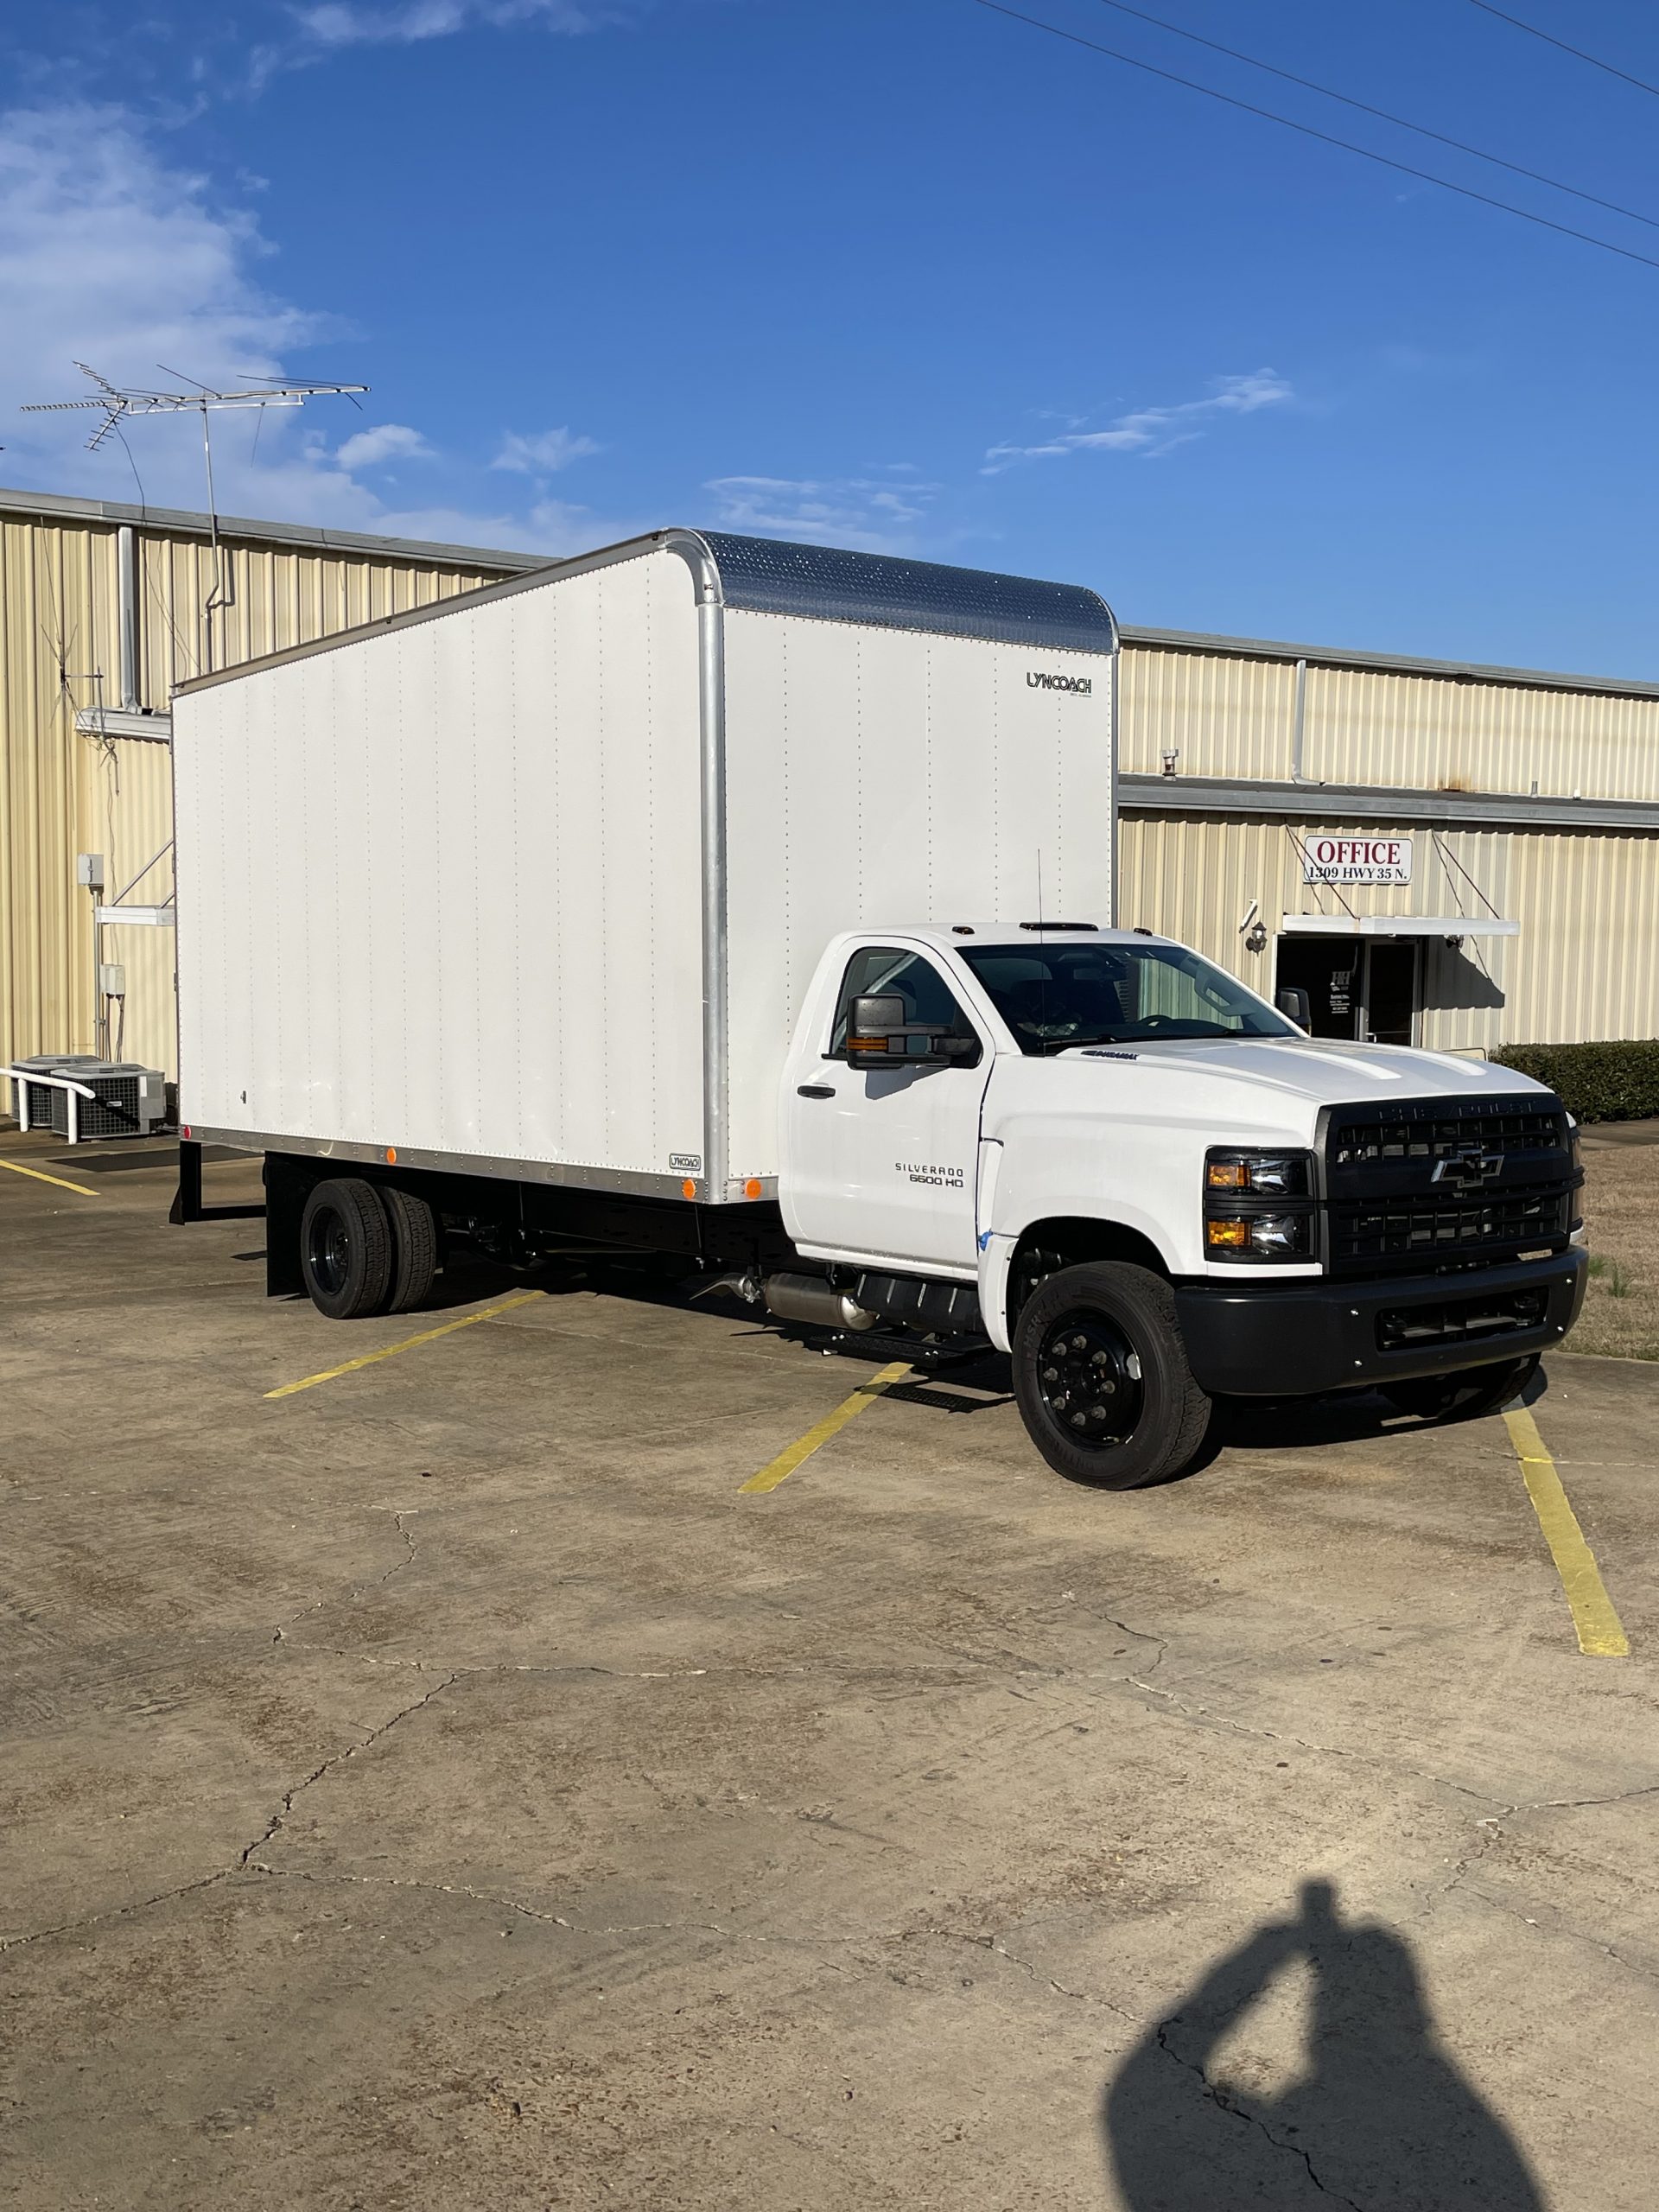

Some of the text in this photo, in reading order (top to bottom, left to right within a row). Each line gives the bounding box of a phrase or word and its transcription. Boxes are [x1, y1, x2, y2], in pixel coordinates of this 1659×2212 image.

[1027, 672, 1092, 693] LYNCOACH
[1317, 841, 1401, 864] OFFICE
[1309, 867, 1408, 880] 1309 HWY 35 N.
[895, 1162, 963, 1177] SILVERADO
[910, 1174, 963, 1188] 6500 HD
